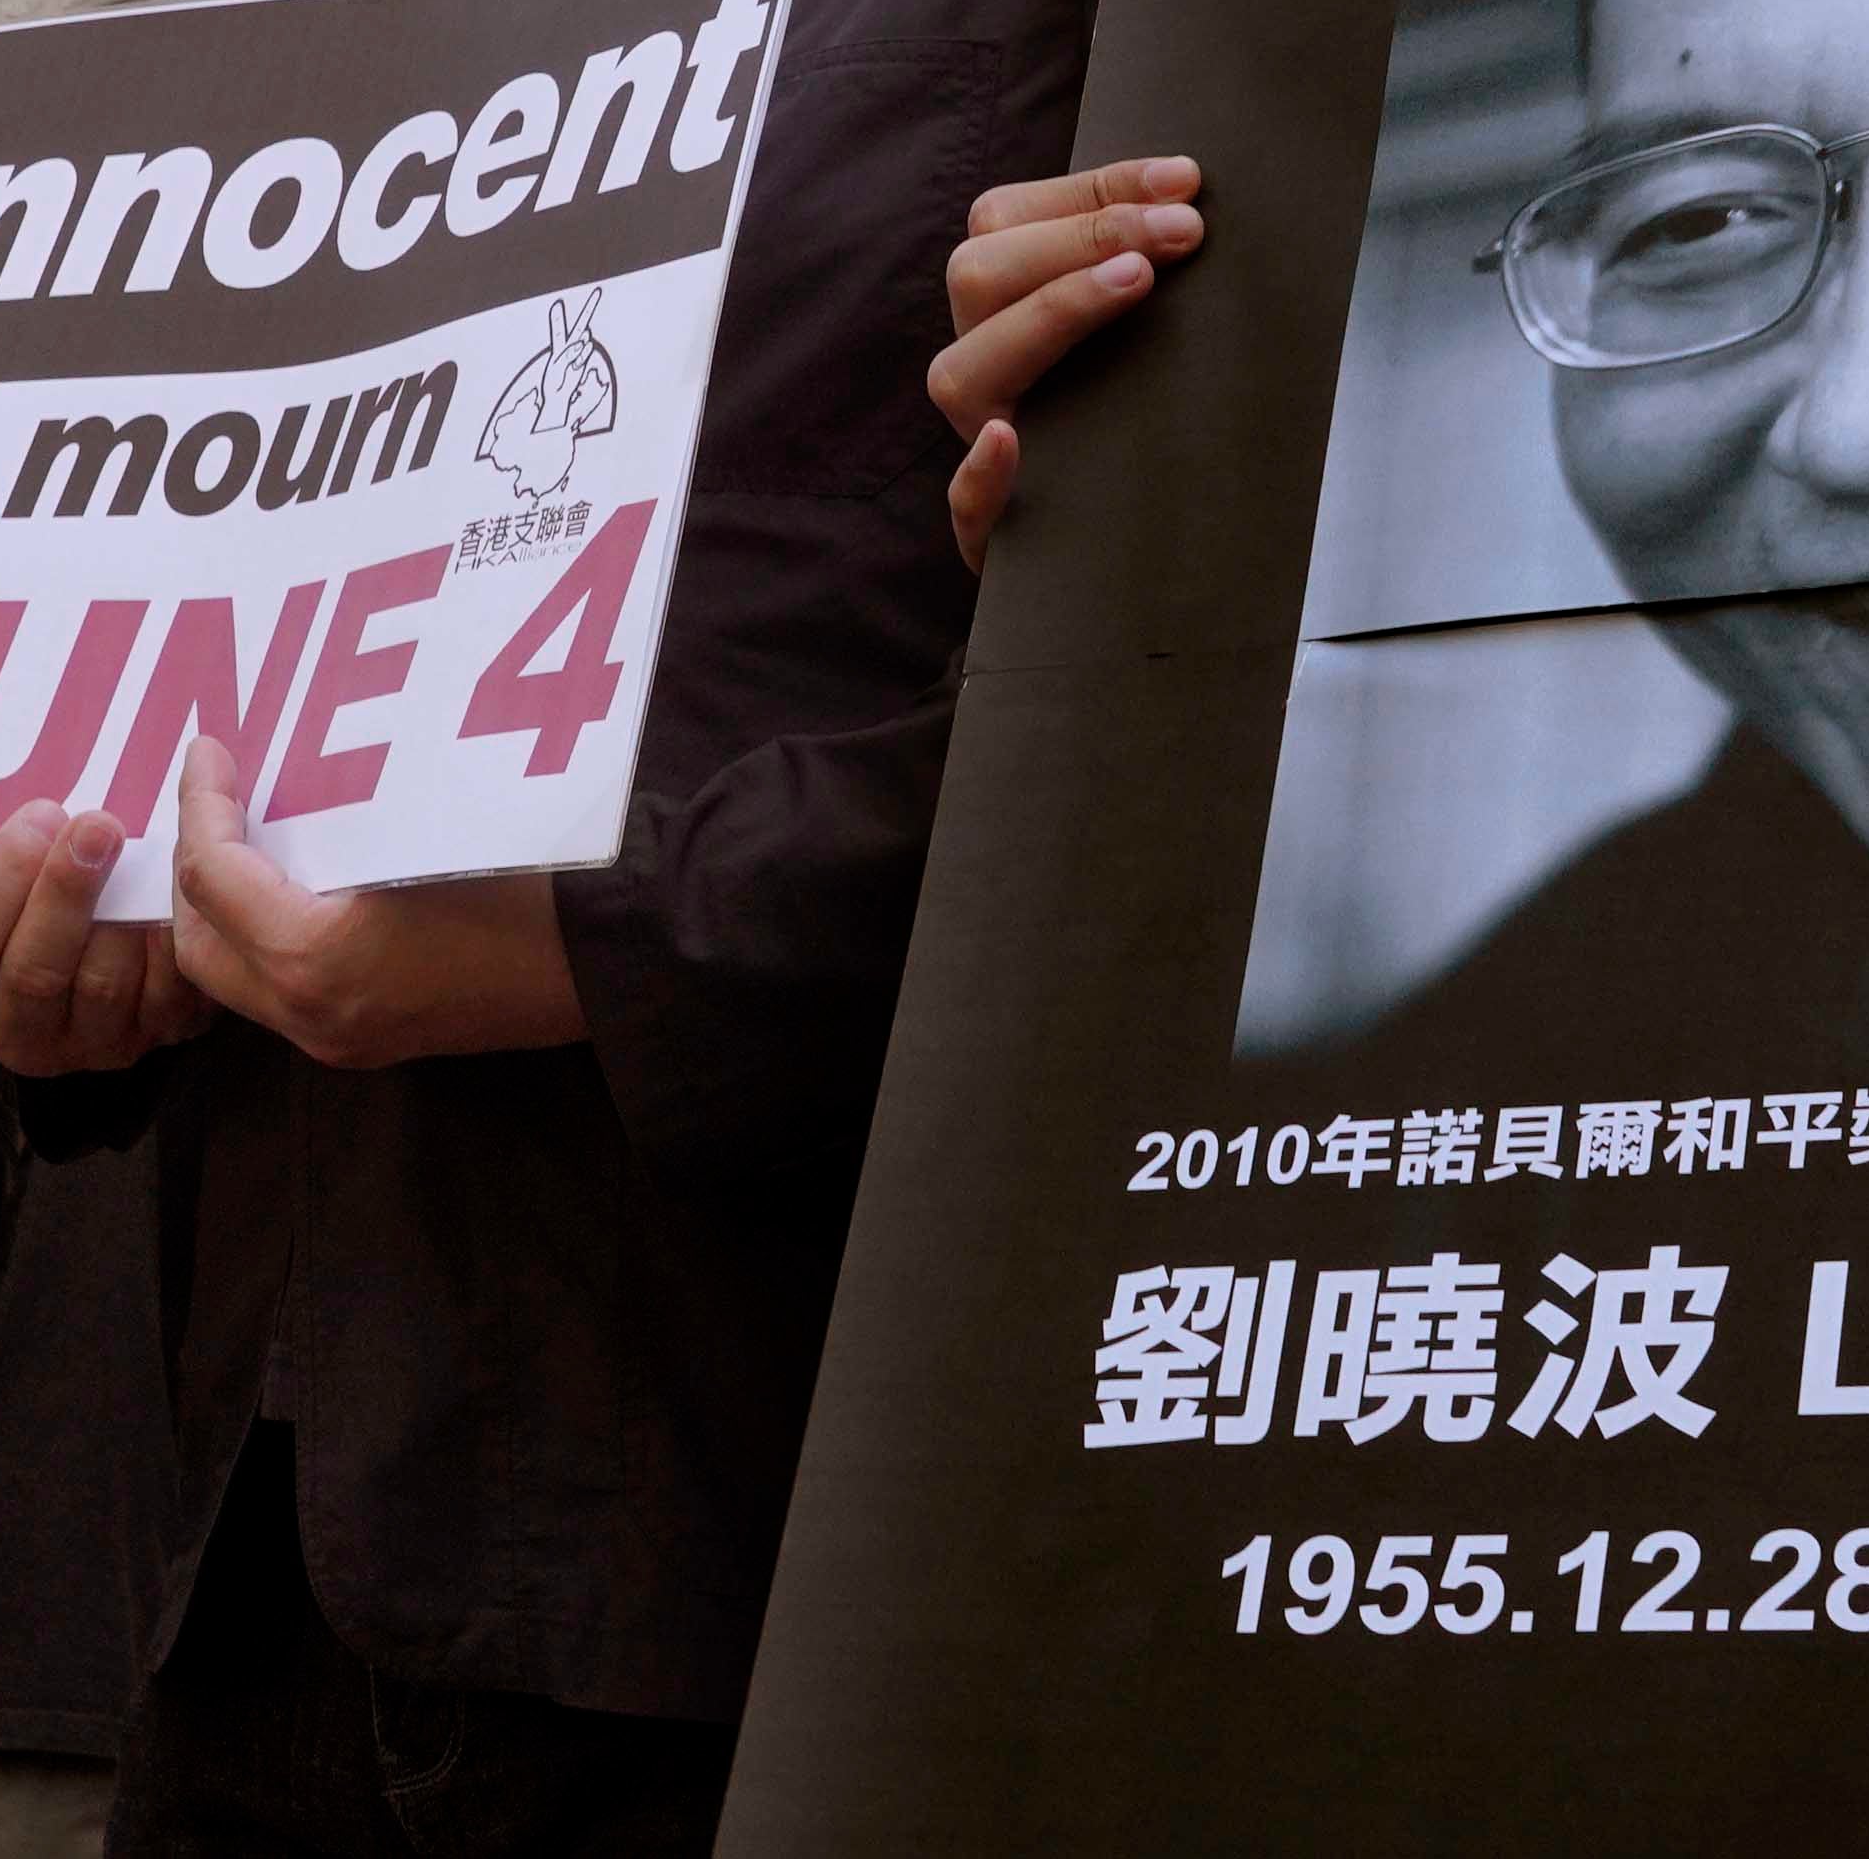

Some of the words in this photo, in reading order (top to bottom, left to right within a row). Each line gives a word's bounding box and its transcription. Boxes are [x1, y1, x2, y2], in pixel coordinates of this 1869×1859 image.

[1, 359, 459, 520] mourn
[457, 499, 594, 561] 香港支聯會
[458, 498, 659, 780] 4
[1083, 1244, 1731, 1450] 劉曉波
